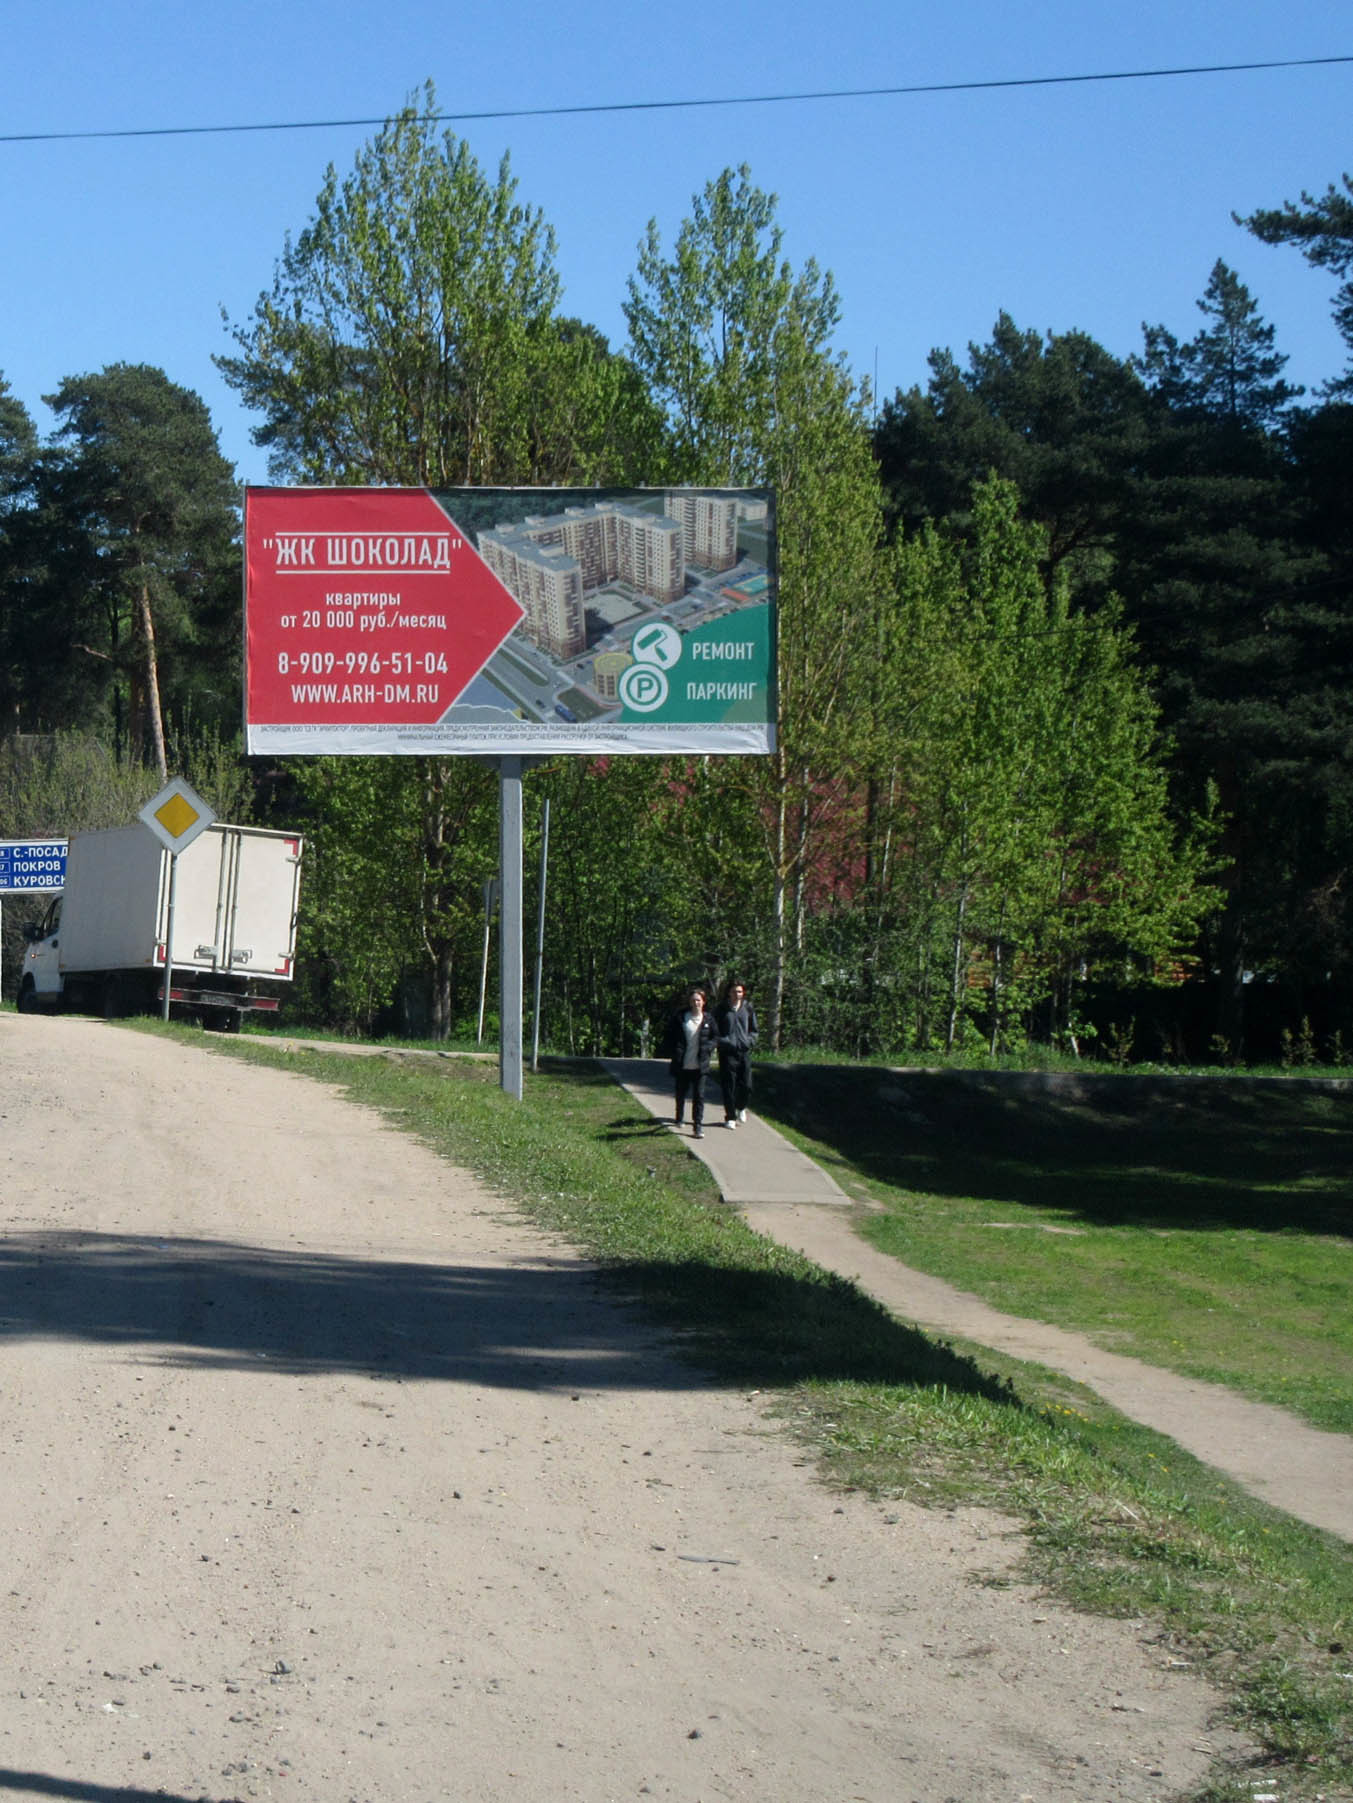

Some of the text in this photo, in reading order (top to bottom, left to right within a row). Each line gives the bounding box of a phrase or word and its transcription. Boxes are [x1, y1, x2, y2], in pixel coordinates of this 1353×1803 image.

[263, 538, 462, 569] "ЖК ШОКОЛАД"
[326, 592, 401, 610] квартиры
[280, 610, 447, 632] от 20 000 руб./месяц
[692, 642, 755, 660] РЕМОНТ
[278, 652, 448, 674] 8-909-996-51-04
[291, 684, 439, 704] WWW.ARH-DM.RU
[687, 682, 757, 700] ПАРКИНГ
[13, 847, 68, 858] С.-ПОСАД
[13, 860, 61, 872] ПОКРОВ
